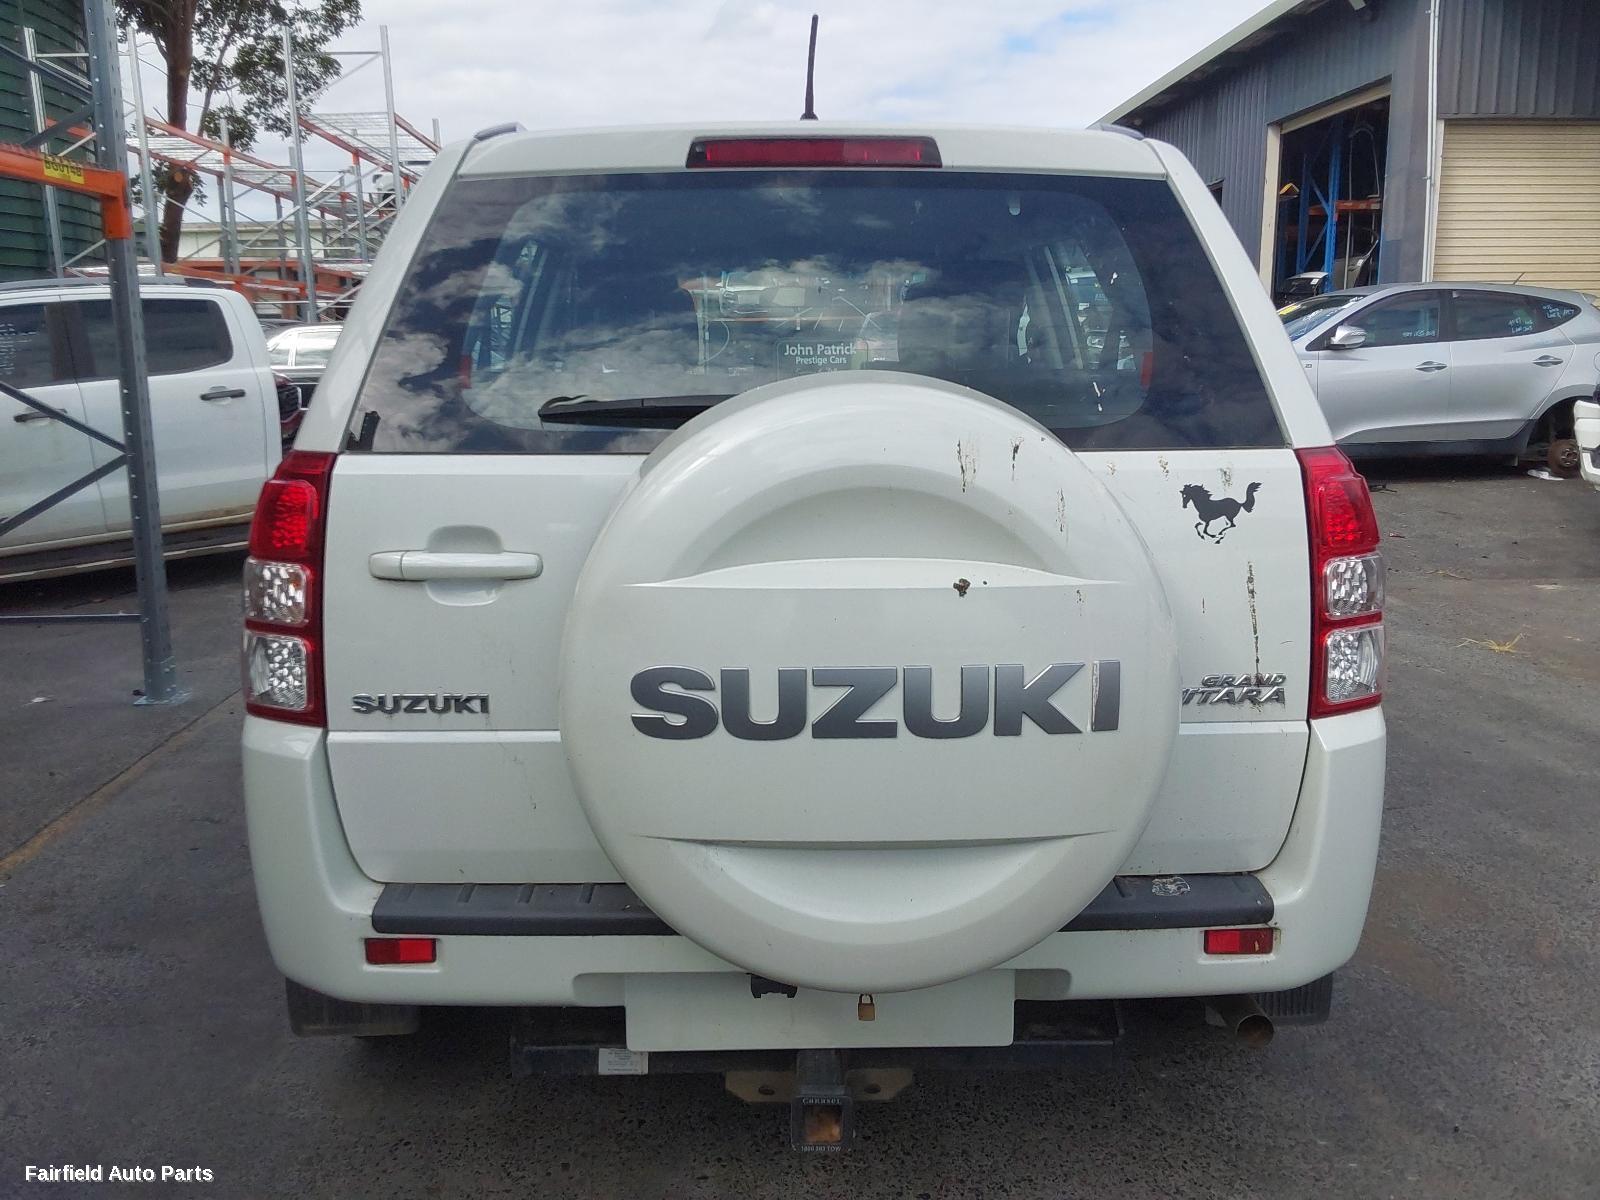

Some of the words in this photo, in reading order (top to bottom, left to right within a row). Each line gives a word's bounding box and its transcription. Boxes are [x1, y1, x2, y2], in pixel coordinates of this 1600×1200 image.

[784, 343, 813, 356] John
[817, 342, 857, 356] Patrick
[795, 355, 828, 365] Prestige
[829, 355, 847, 365] Cars
[1201, 673, 1287, 687] GRAND
[351, 692, 489, 714] SUZUKI
[630, 659, 1121, 741] SUZUKI
